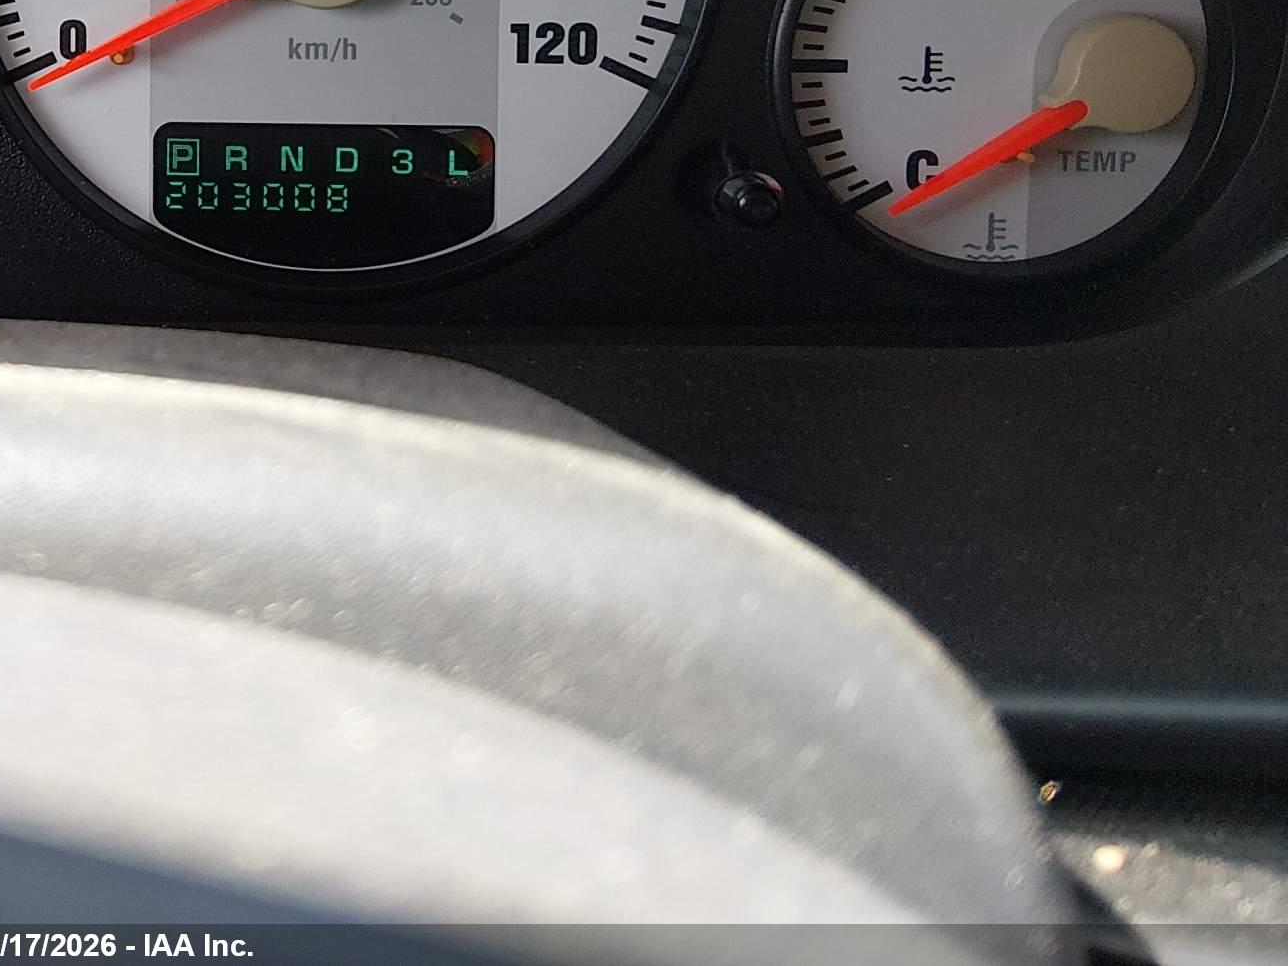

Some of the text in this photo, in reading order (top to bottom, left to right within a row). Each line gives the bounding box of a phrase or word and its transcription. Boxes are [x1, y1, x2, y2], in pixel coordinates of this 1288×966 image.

[59, 19, 87, 60] 0
[289, 38, 356, 62] km/h
[511, 22, 597, 65] 120
[173, 145, 468, 175] P R N D 3 L
[906, 150, 939, 190] C
[1057, 150, 1136, 172] TEMP
[166, 182, 347, 212] 203008
